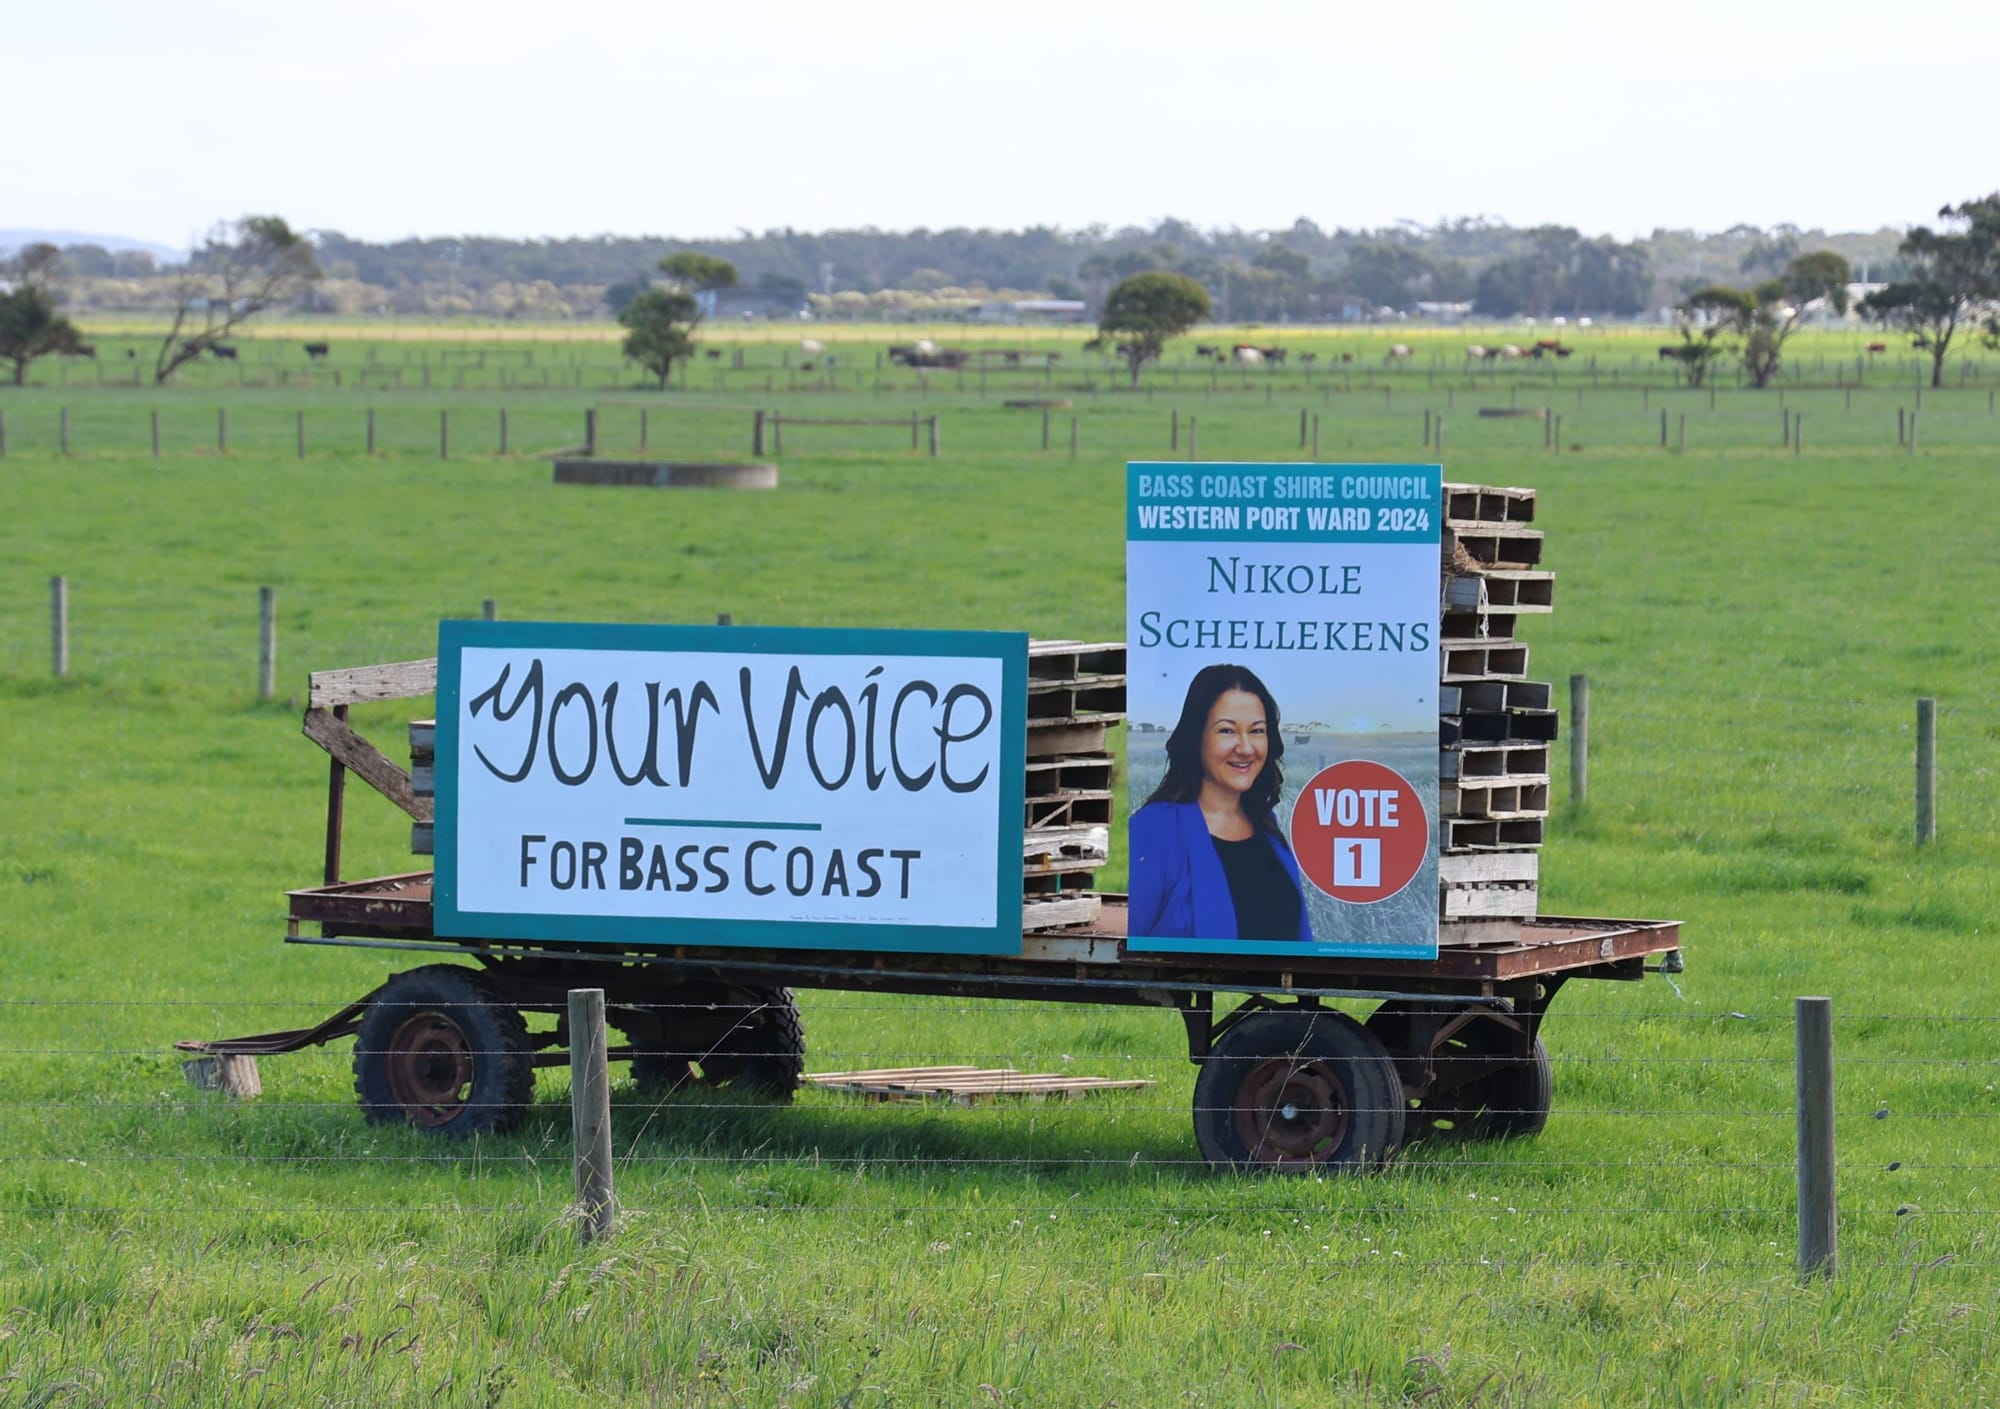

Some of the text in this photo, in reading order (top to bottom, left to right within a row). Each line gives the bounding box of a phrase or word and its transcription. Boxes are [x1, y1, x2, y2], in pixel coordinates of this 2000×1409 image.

[1138, 474, 1431, 500] BASS COAST SHIRE COUNCIL
[1137, 505, 1430, 532] WESTERN PORT WARD 2024
[1206, 556, 1362, 595] NIKOLE
[1138, 610, 1430, 652] SCHELLEKENS
[1314, 788, 1400, 828] VOTE
[744, 840, 921, 899] COAST
[1348, 843, 1362, 879] 1
